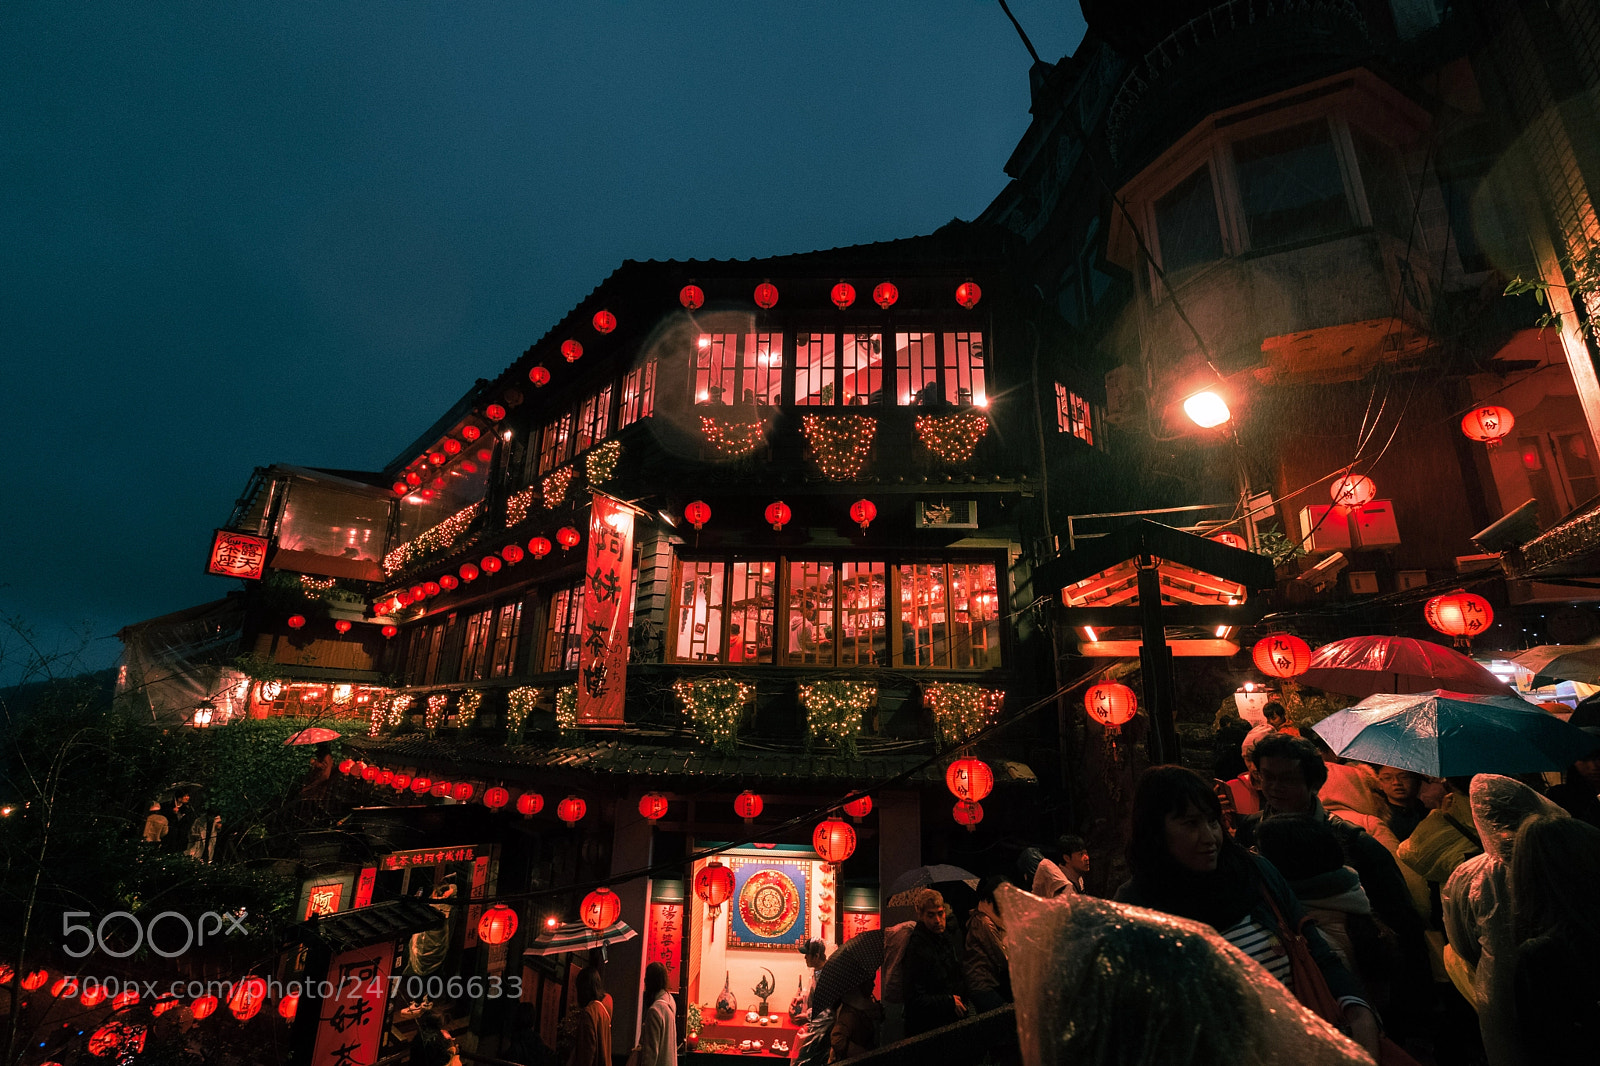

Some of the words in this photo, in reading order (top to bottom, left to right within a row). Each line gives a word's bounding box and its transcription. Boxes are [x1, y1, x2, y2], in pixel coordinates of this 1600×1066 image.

[1481, 408, 1498, 431] 九份
[583, 527, 625, 698] 阿妹茶樓
[1467, 600, 1483, 631] 九份
[1274, 639, 1292, 670] 九份
[1094, 689, 1109, 718] 九份
[956, 768, 968, 796] 九份
[818, 827, 828, 857] 九份
[588, 902, 599, 927] 九份
